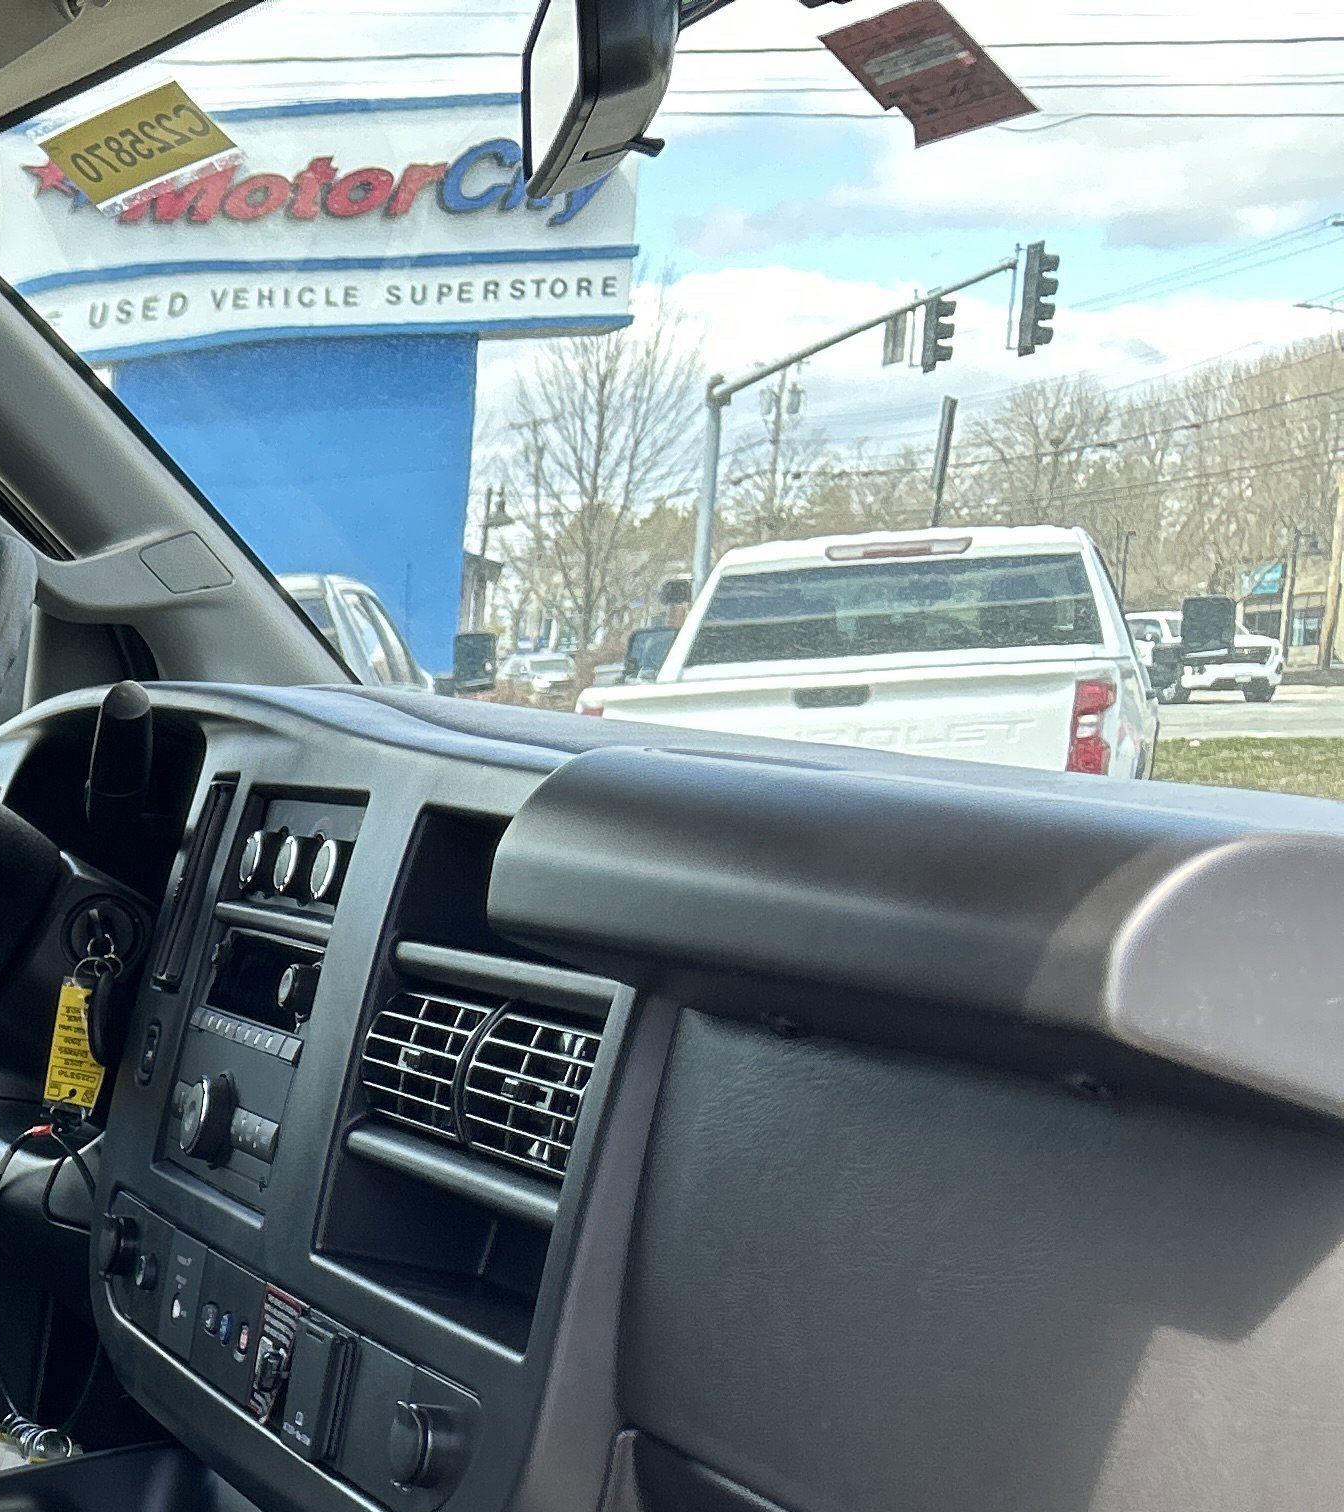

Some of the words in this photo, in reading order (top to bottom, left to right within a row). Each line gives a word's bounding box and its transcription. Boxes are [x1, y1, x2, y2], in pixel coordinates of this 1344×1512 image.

[89, 291, 188, 329] USED
[210, 286, 359, 311] VEHICLE
[385, 275, 618, 306] SUPERSTORE
